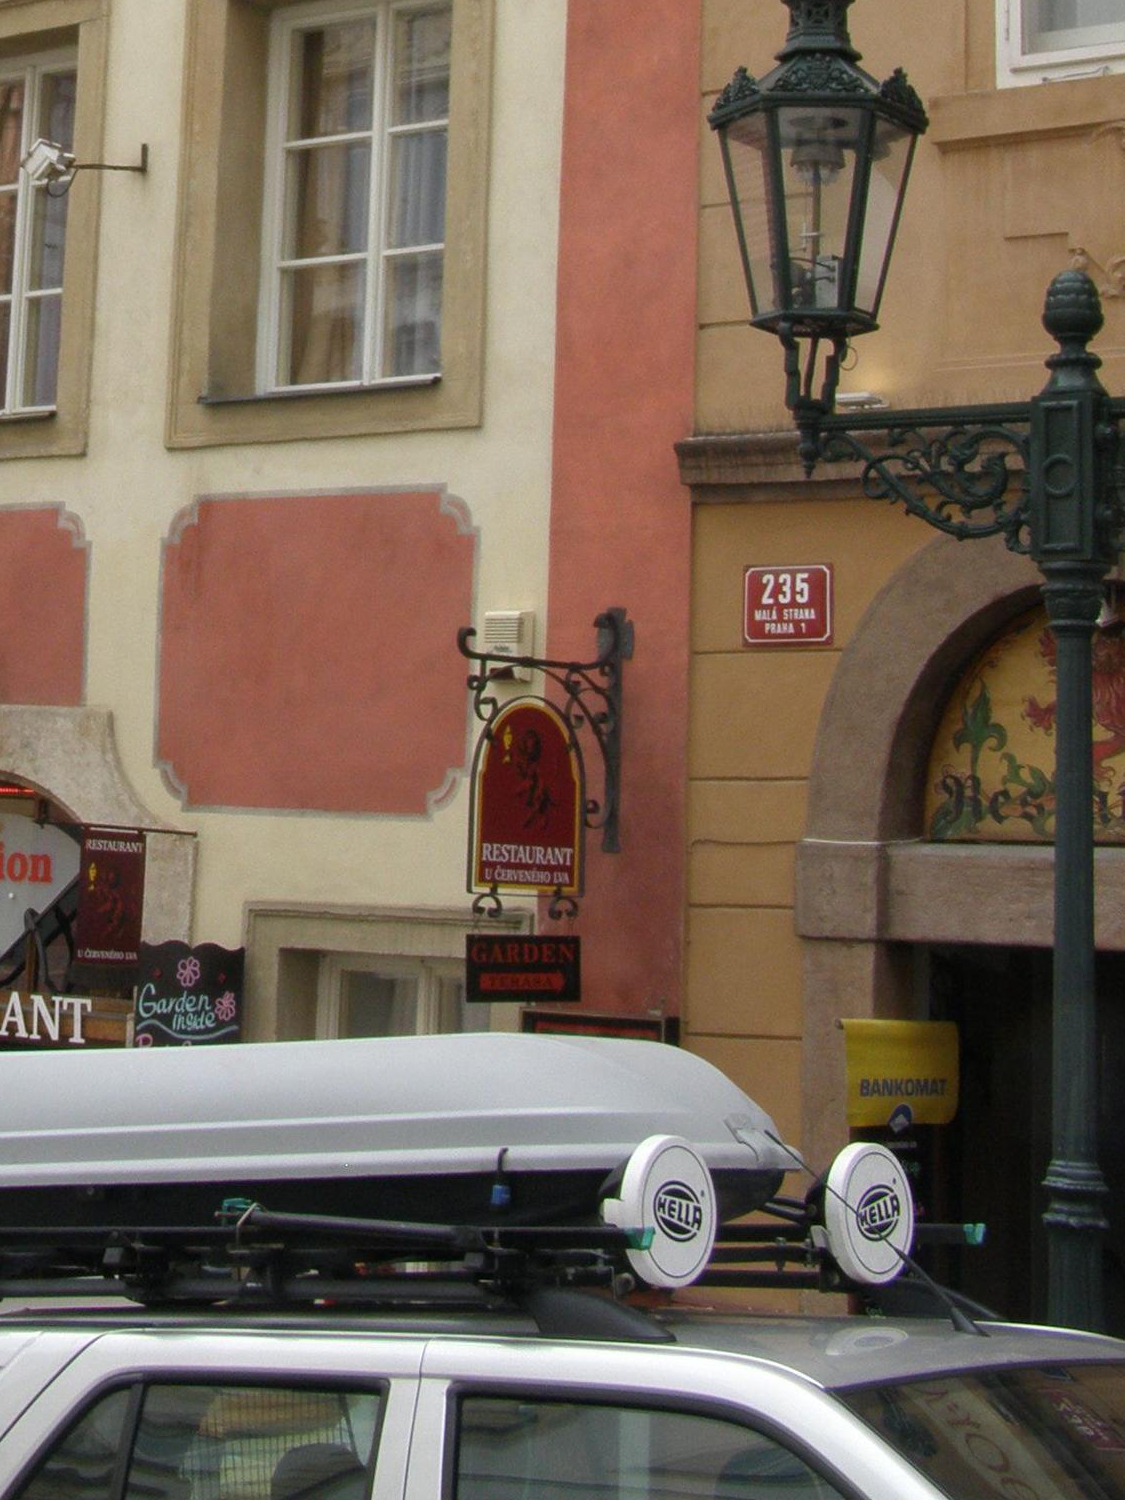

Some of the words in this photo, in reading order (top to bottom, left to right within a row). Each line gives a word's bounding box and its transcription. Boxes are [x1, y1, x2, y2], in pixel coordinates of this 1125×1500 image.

[761, 572, 810, 605] 235
[754, 606, 778, 620] MALÁ
[782, 608, 816, 620] STRANA
[764, 622, 795, 634] PRAHA
[800, 622, 806, 634] 1
[85, 838, 144, 853] RESTAURANT
[482, 842, 574, 866] RESTAURANT
[484, 867, 492, 880] U
[494, 865, 551, 884] ČERVENÉHO
[470, 942, 575, 965] GARDEN
[138, 982, 212, 1018] Garden
[858, 1077, 948, 1098] BANKOMAT
[657, 1196, 703, 1230] HELLA
[859, 1193, 901, 1228] HELLA
